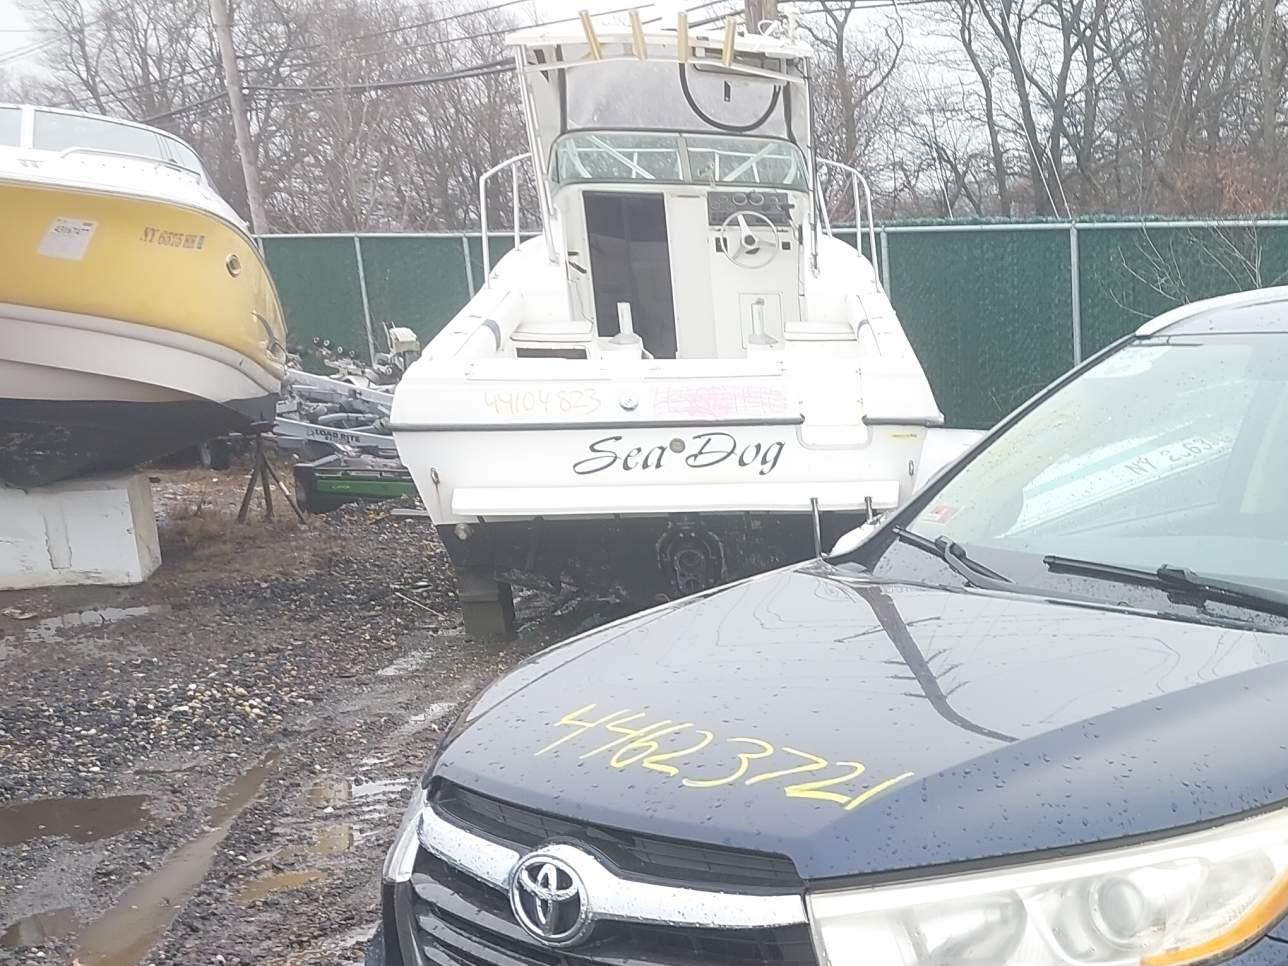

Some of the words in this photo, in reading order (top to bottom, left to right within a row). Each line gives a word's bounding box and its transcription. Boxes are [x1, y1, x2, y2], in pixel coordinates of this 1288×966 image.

[573, 434, 668, 475] Sea
[685, 432, 786, 476] Dog
[533, 703, 916, 811] 44623721
